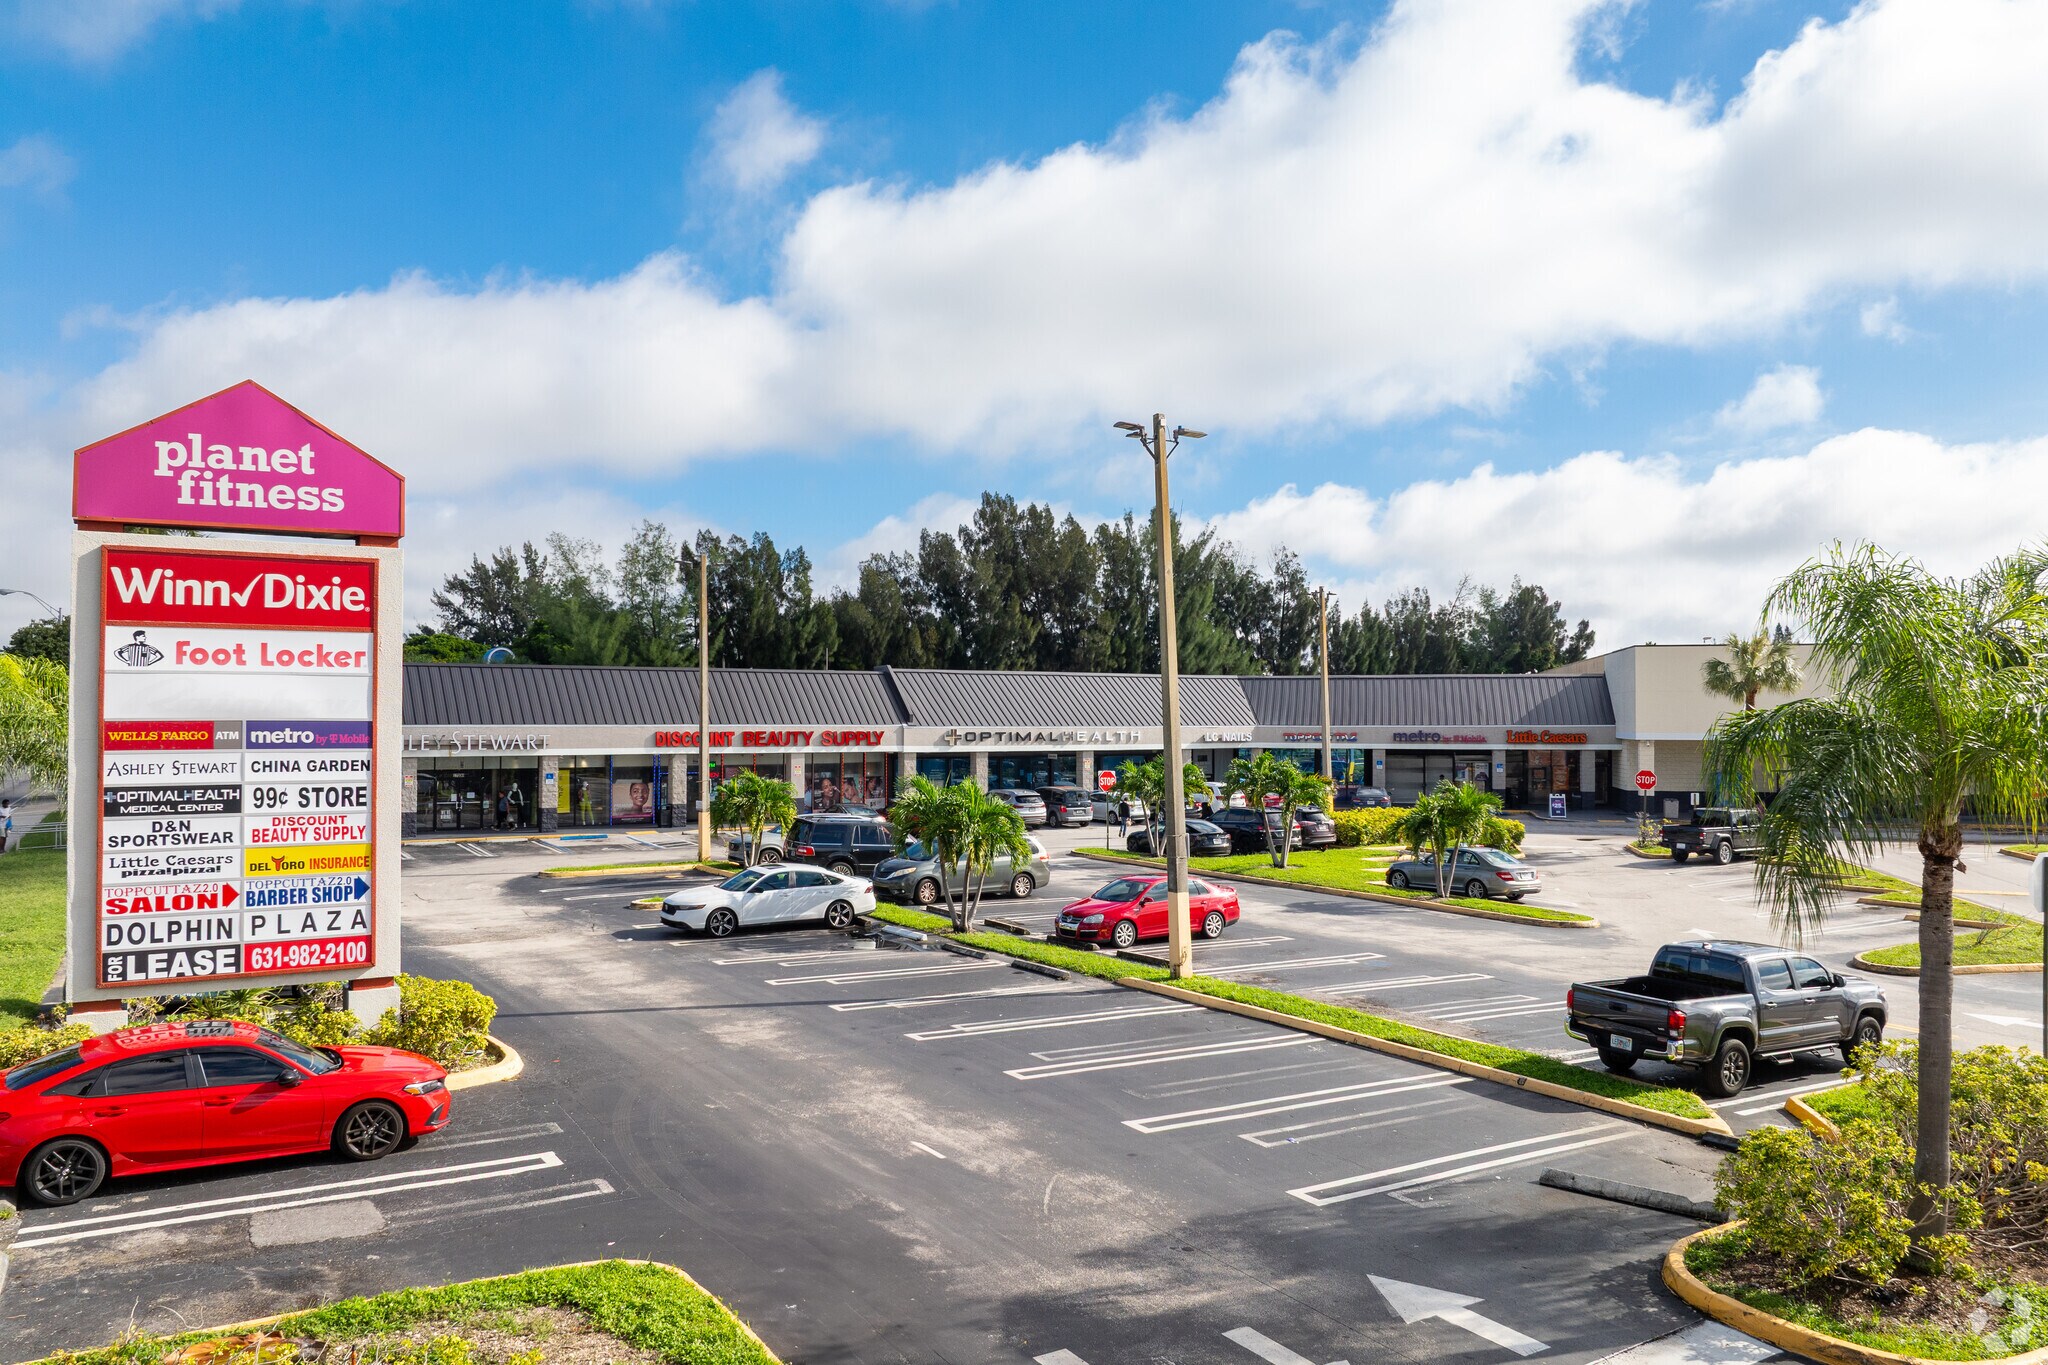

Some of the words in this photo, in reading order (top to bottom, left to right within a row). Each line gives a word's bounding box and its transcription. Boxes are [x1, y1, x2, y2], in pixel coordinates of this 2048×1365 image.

[154, 433, 315, 476] planet
[177, 470, 345, 512] fitness
[110, 566, 231, 606] Winn
[263, 573, 366, 612] Dixie
[175, 640, 246, 667] Foot
[260, 642, 366, 668] Locker
[108, 731, 158, 741] WELLS
[161, 731, 208, 741] FARGO
[215, 731, 239, 740] ATM
[250, 727, 315, 744] metro
[316, 734, 328, 746] by
[450, 731, 551, 754] STEWART
[743, 731, 814, 746] BEAUTY
[821, 730, 884, 746] SUPPLY
[1223, 732, 1252, 742] NAILS
[1393, 730, 1441, 743] metro
[1506, 730, 1538, 744] Little
[1540, 730, 1588, 744] Caesars
[107, 761, 165, 777] ASHLEY
[171, 760, 237, 776] STEWART
[251, 760, 301, 773] CHINA
[306, 759, 371, 773] GARDEN
[1100, 777, 1115, 786] STOP
[1636, 775, 1656, 784] STOP
[253, 786, 289, 809] 99¢
[297, 786, 367, 808] STORE
[120, 804, 175, 814] MEDICAL
[177, 803, 224, 812] CENTER
[152, 820, 191, 833] D&N
[272, 815, 348, 827] DISCOUNT
[108, 831, 234, 848] SPORTSWEAR
[251, 826, 313, 843] BEAUTY
[314, 825, 366, 841] SUPPLY
[109, 856, 160, 869] Little
[165, 855, 233, 866] Caesars
[249, 862, 271, 872] DEL
[309, 856, 370, 870] INSURANCE
[106, 893, 218, 915] SALON
[245, 888, 308, 907] BARBER
[312, 885, 353, 904] SHOP
[106, 917, 233, 946] DOLPHIN
[251, 909, 367, 937] PLAZA
[251, 941, 367, 970] 631-982-2100
[107, 955, 123, 982] FOR
[126, 948, 236, 981] LEASE
